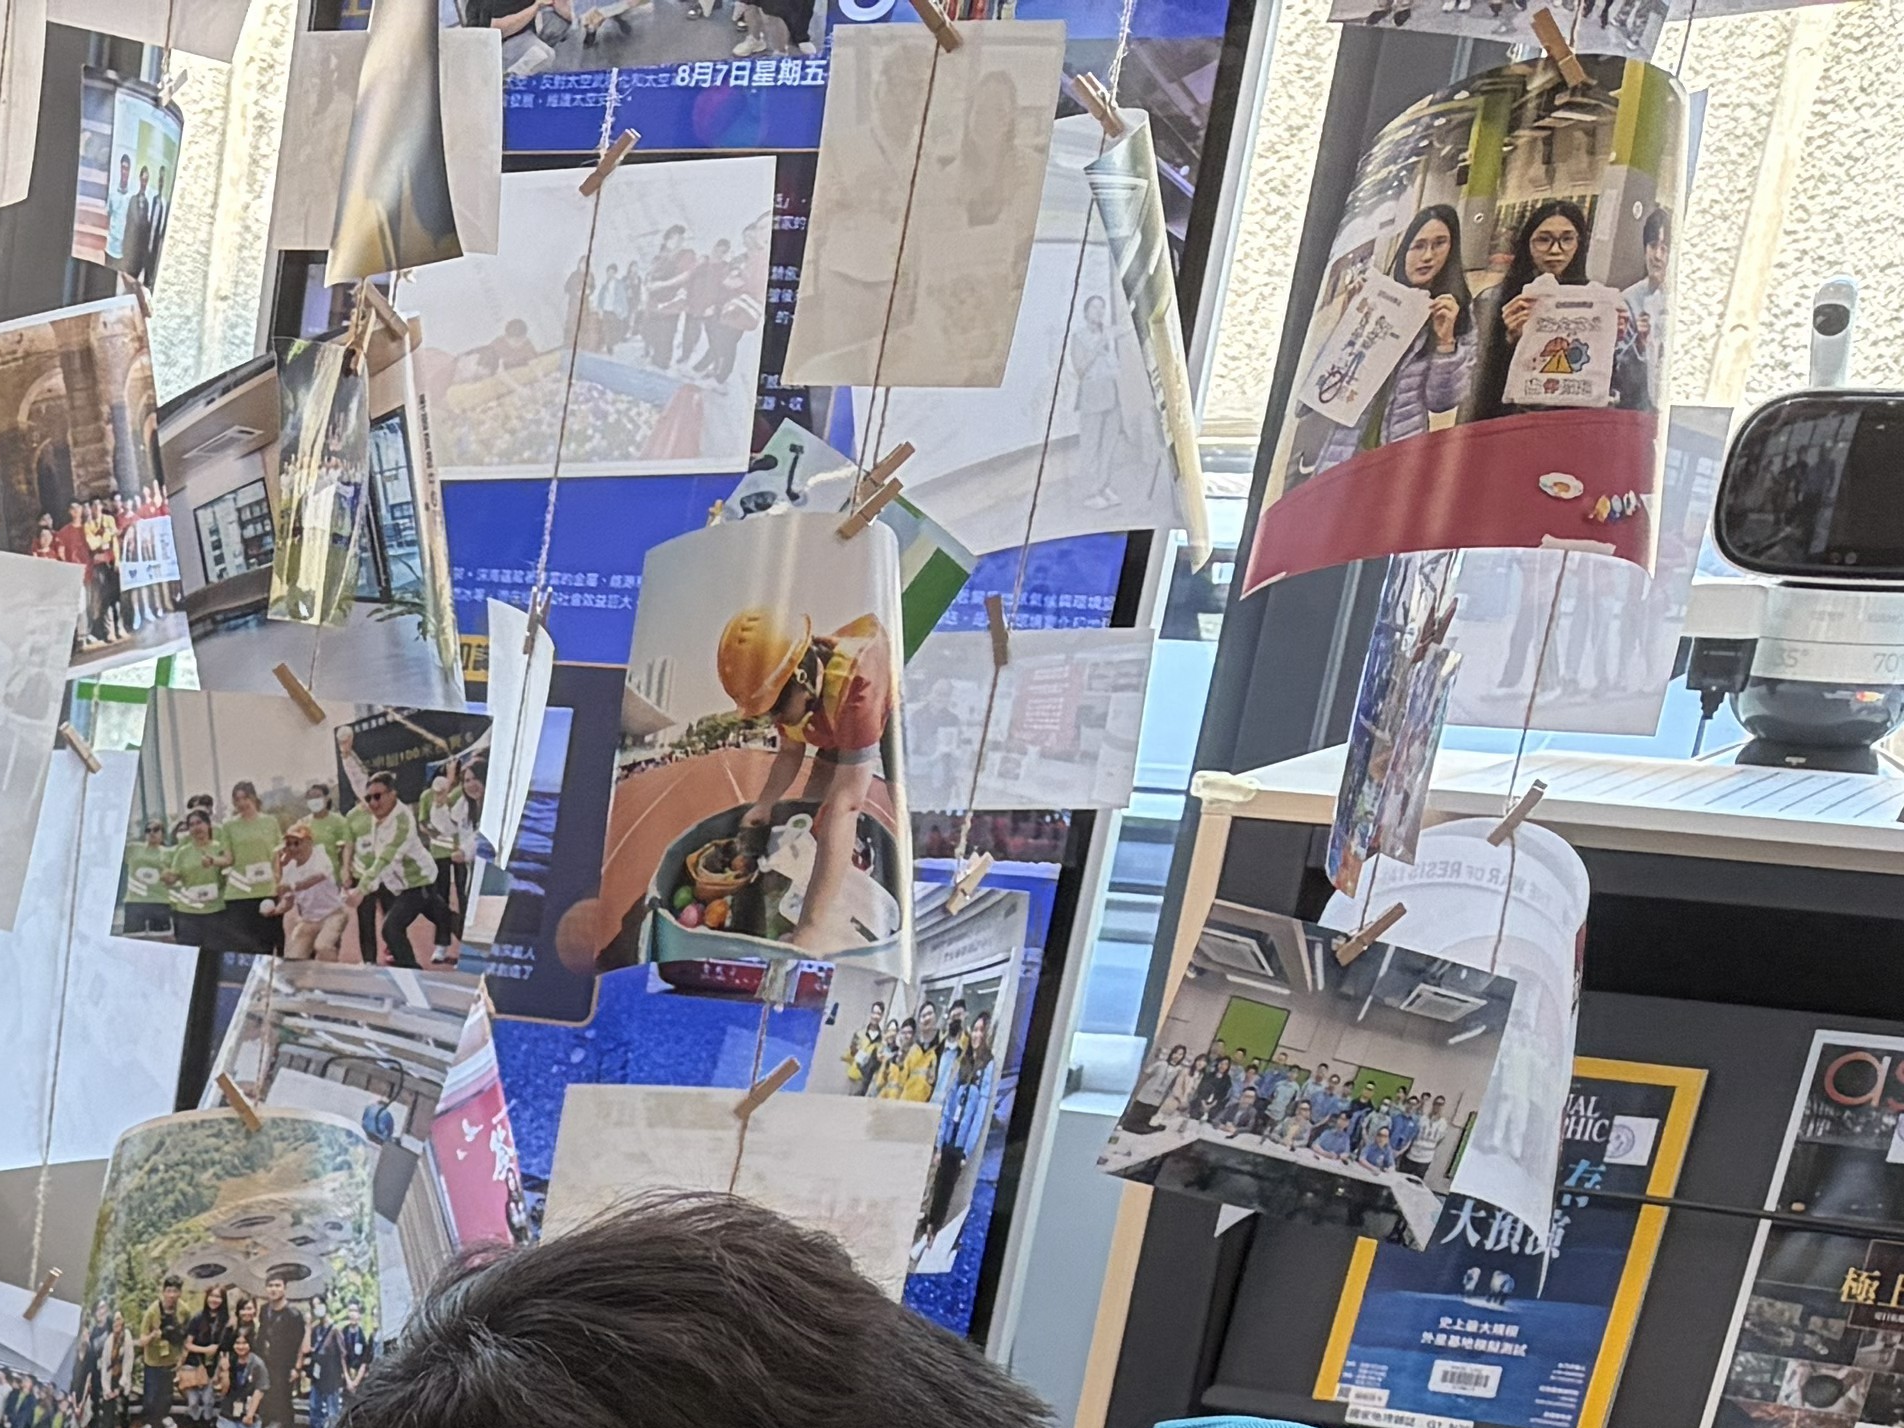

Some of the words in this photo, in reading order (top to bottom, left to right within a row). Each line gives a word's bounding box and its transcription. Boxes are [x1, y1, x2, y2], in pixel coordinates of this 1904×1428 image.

[676, 60, 827, 88] 8月7日星期五
